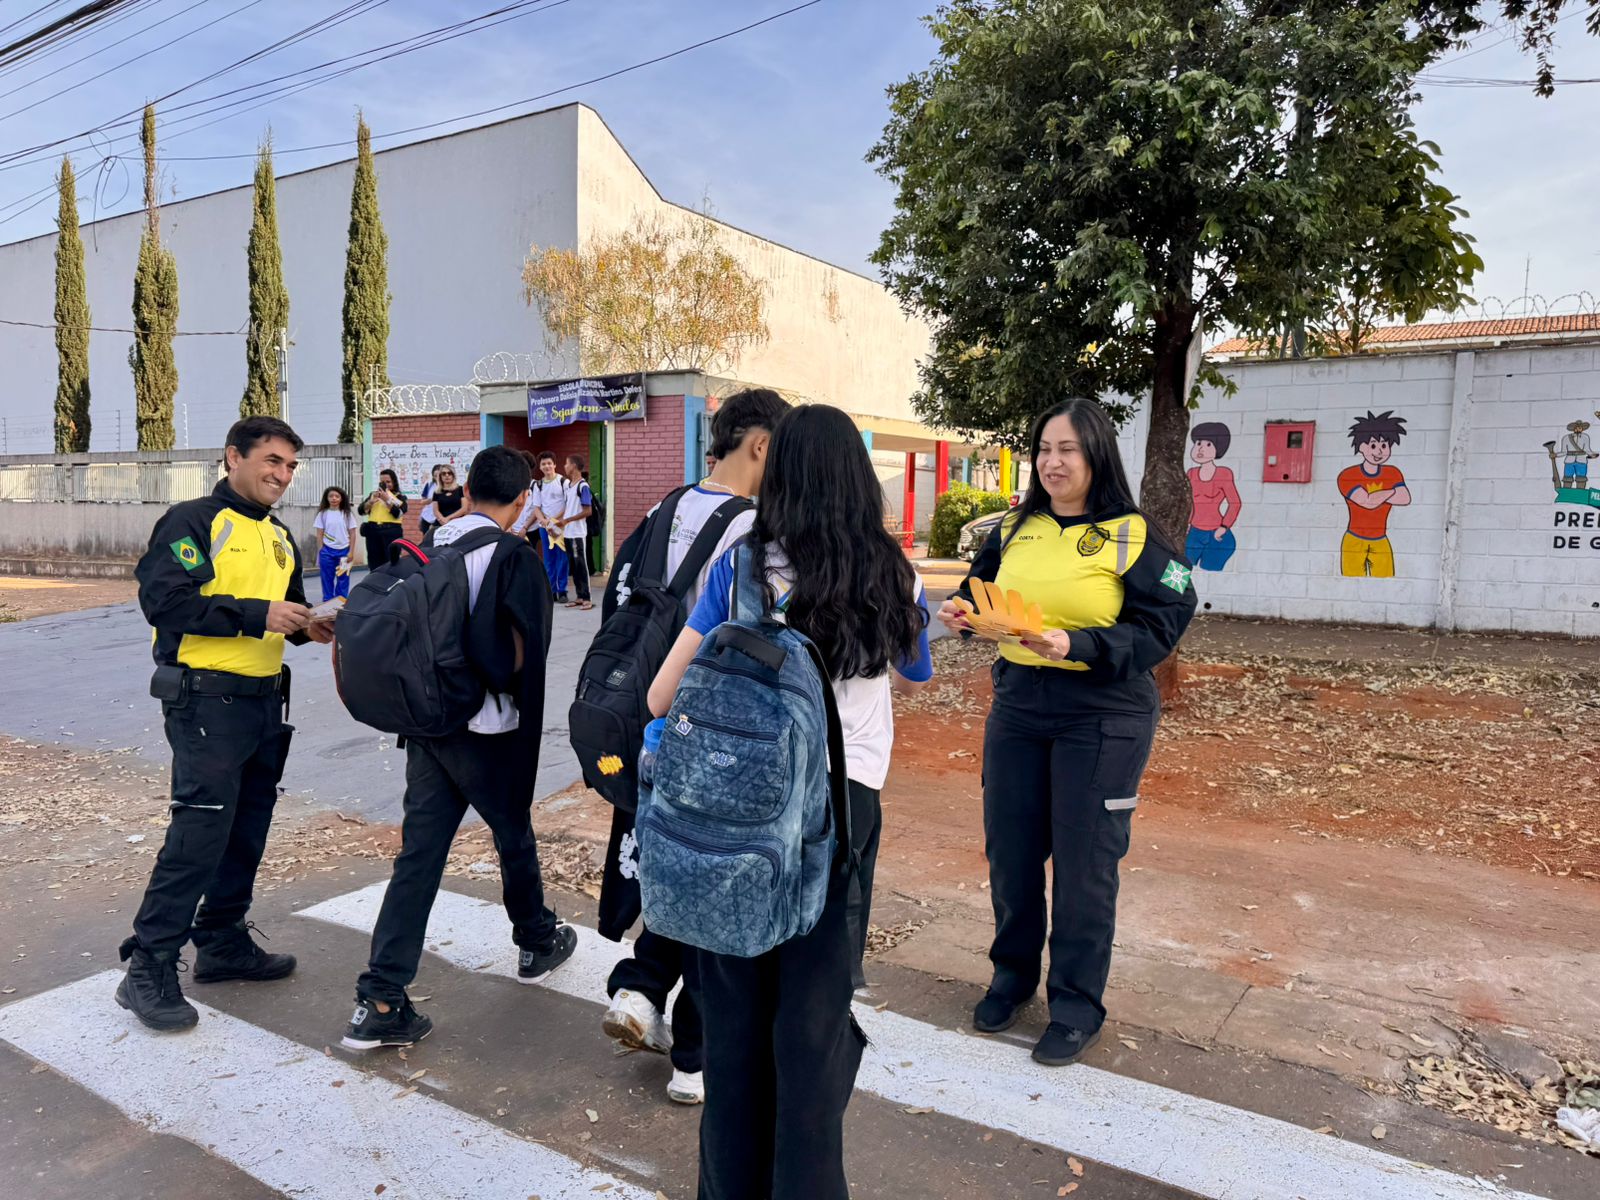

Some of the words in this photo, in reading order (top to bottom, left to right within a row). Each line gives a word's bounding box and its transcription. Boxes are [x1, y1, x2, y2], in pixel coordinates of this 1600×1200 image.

[558, 381, 579, 393] ESCOLA
[531, 396, 559, 406] Professora
[551, 405, 577, 423] Sejam
[1553, 511, 1600, 528] PRE
[1553, 535, 1581, 549] DE
